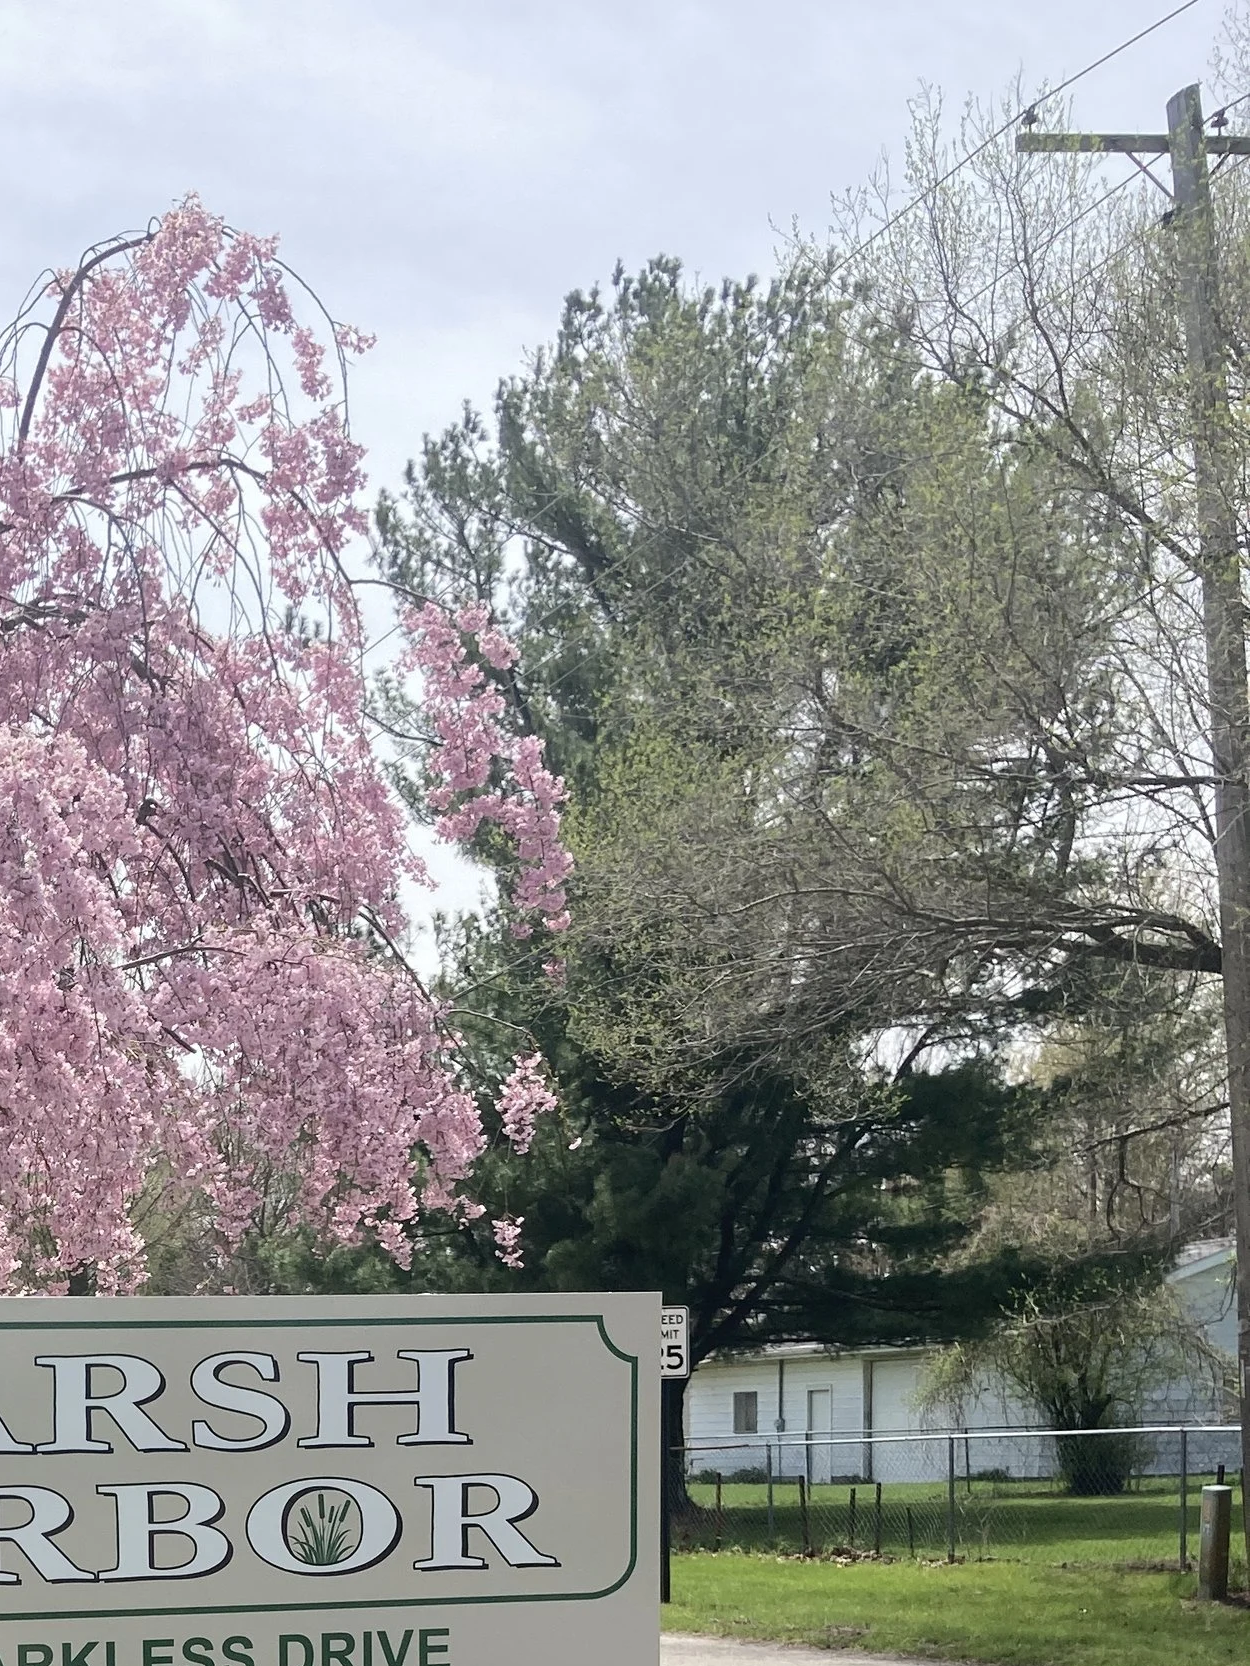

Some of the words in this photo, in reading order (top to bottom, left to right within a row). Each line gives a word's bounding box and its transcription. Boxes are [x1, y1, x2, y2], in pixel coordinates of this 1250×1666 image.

[661, 1315, 683, 1325] EED
[661, 1330, 679, 1340] MIT
[661, 1345, 683, 1369] 5
